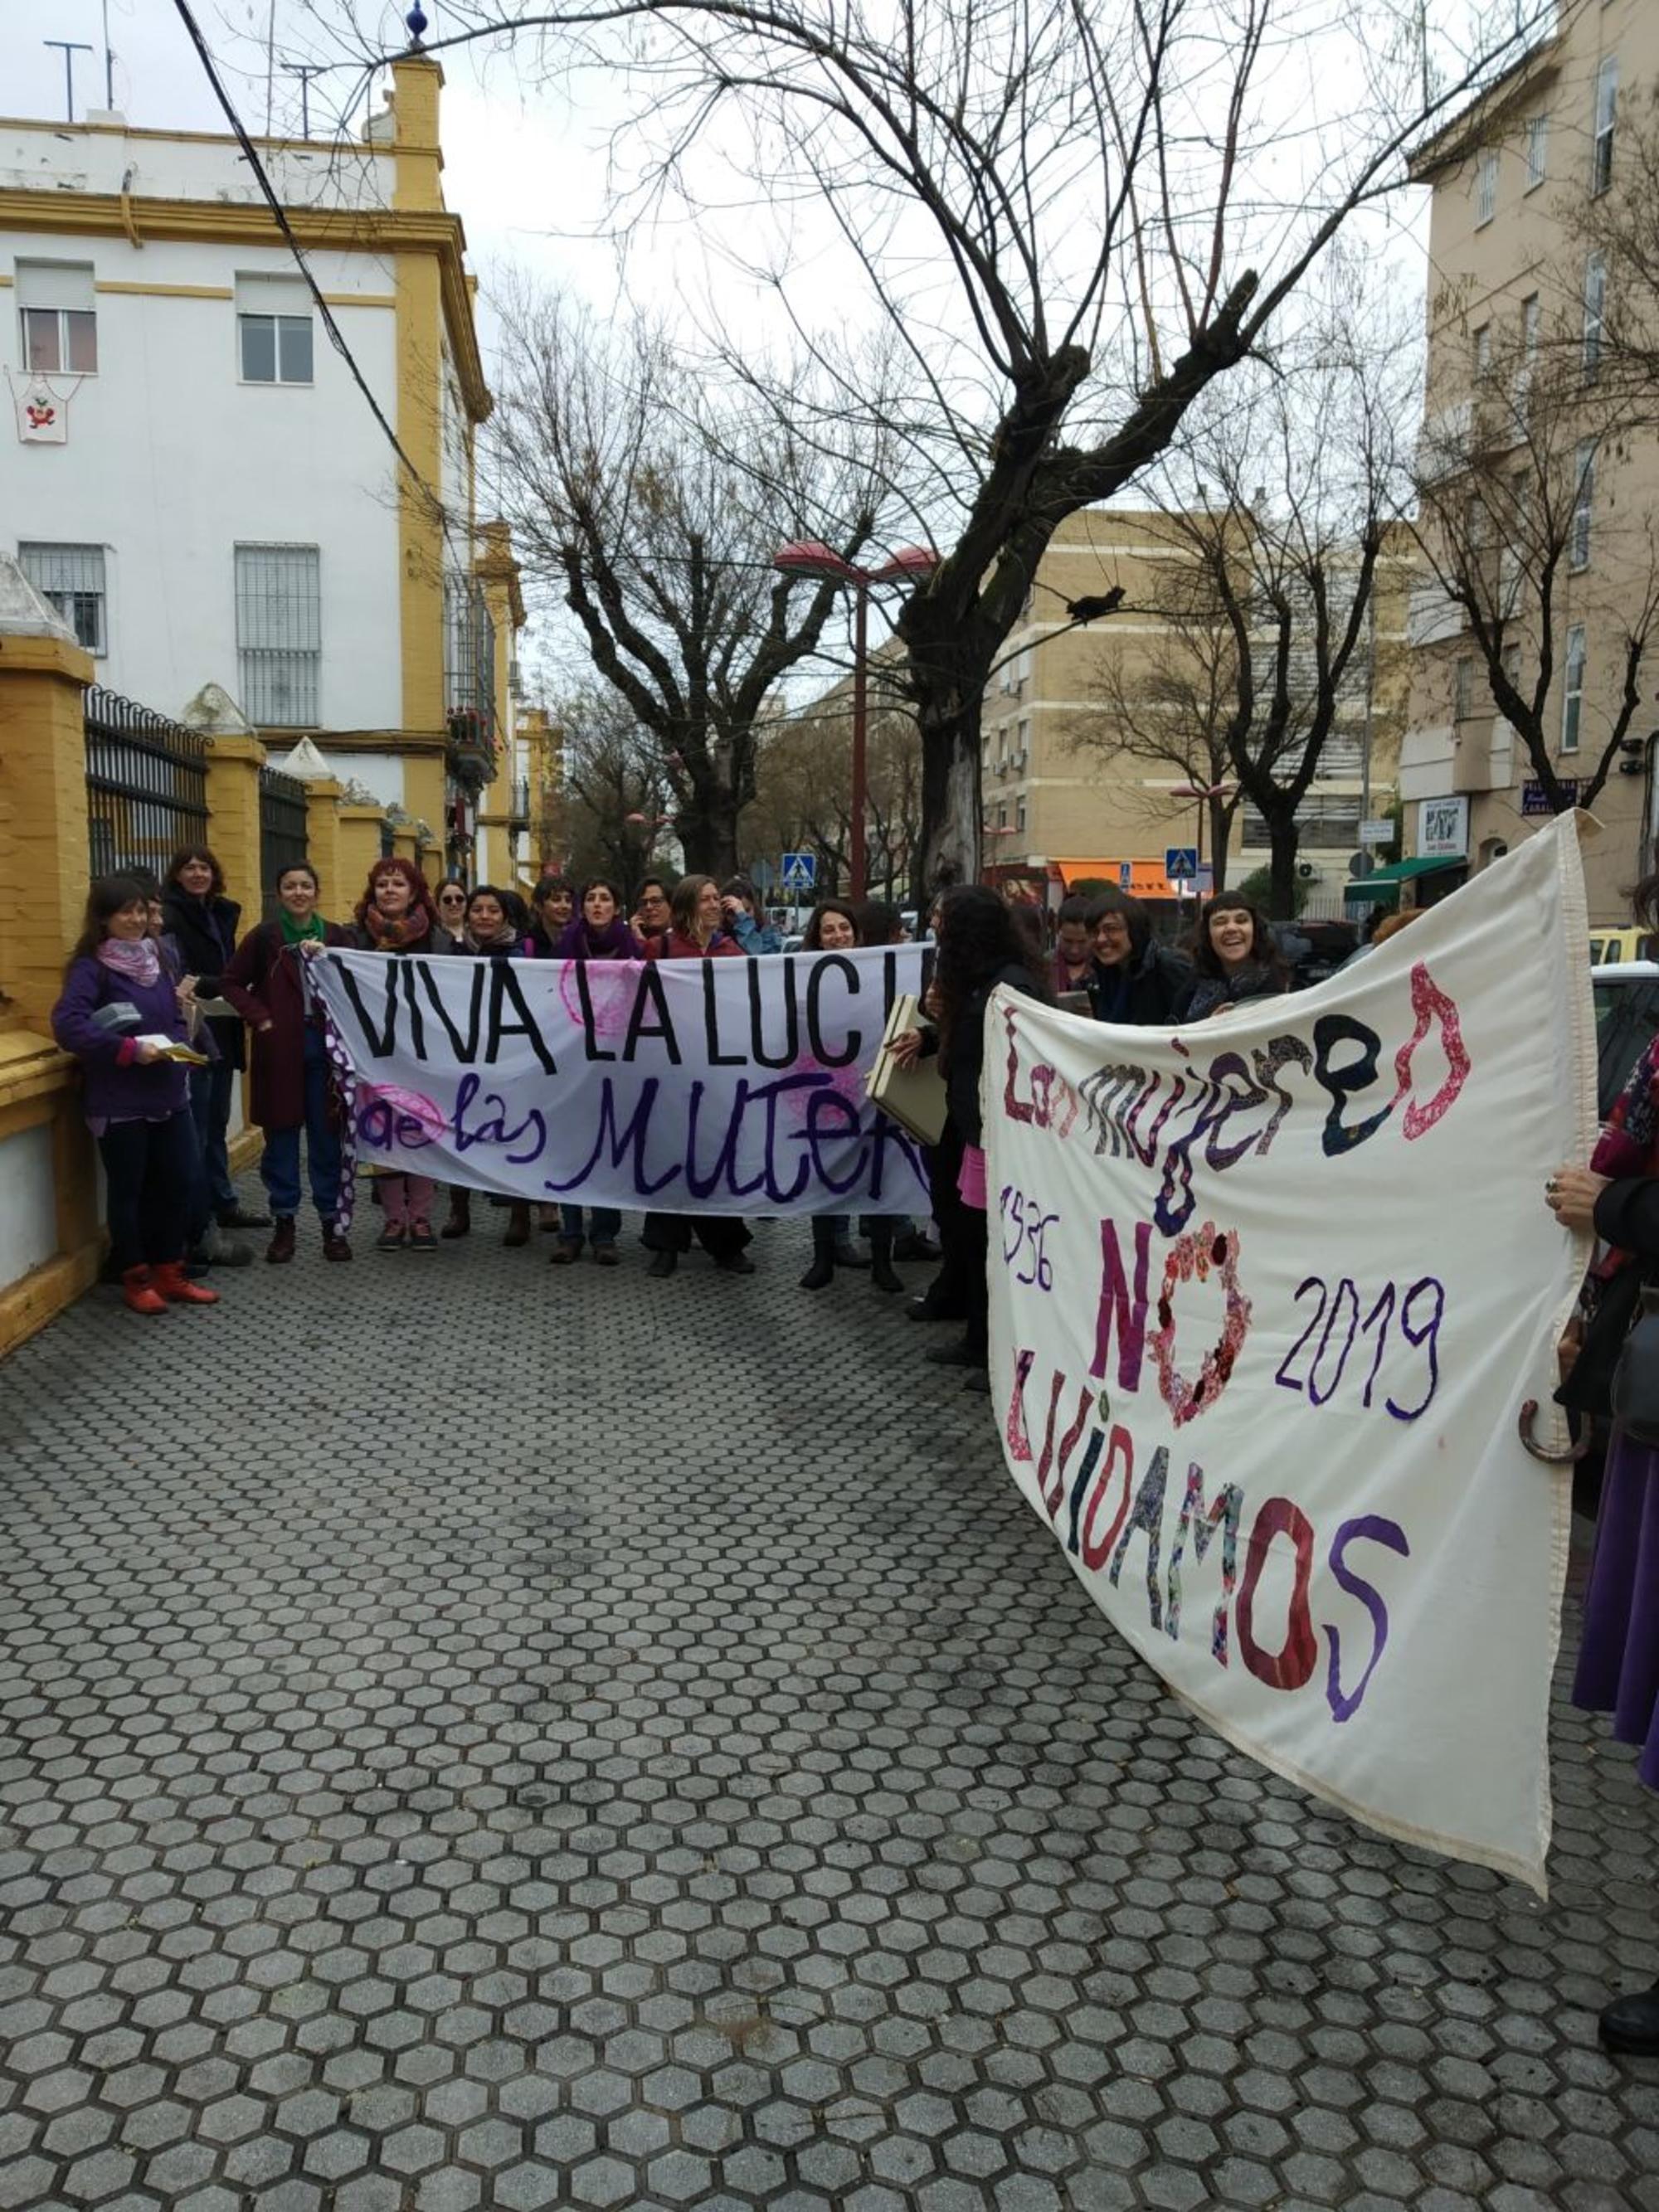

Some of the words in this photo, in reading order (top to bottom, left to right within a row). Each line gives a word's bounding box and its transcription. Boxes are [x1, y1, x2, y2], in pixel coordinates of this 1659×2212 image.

[328, 955, 557, 1076] VIVA
[576, 959, 681, 1066] LA
[1000, 1185, 1060, 1292] 1936
[1089, 1218, 1253, 1429] NO
[1274, 1275, 1446, 1421] 2019
